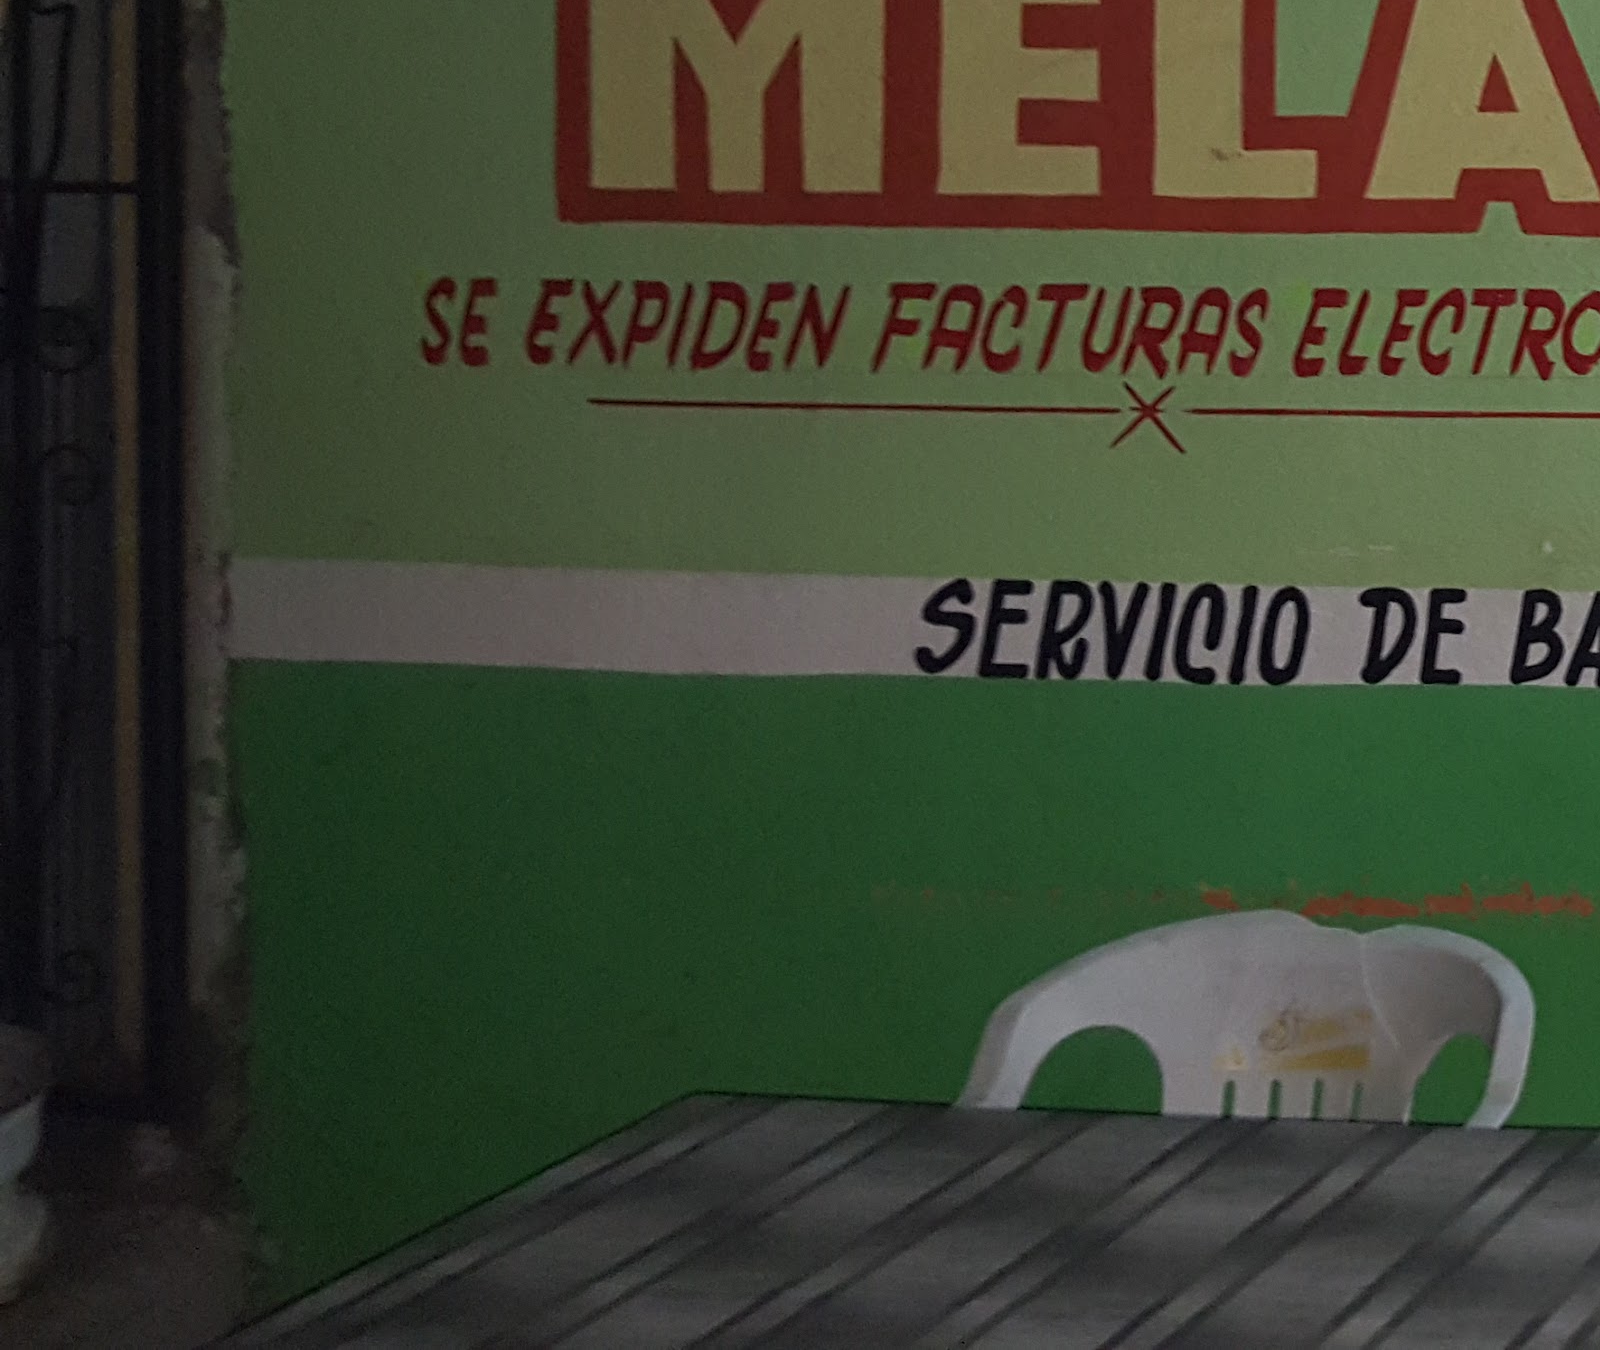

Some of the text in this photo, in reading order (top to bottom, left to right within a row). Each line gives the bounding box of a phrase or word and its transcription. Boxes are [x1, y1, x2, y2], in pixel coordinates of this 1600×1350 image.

[420, 277, 489, 368] SE
[524, 278, 850, 373] EXPIDEN
[873, 282, 1271, 380] FACTURAS
[913, 576, 1312, 693] SERVICIO
[1357, 585, 1470, 688] DE
